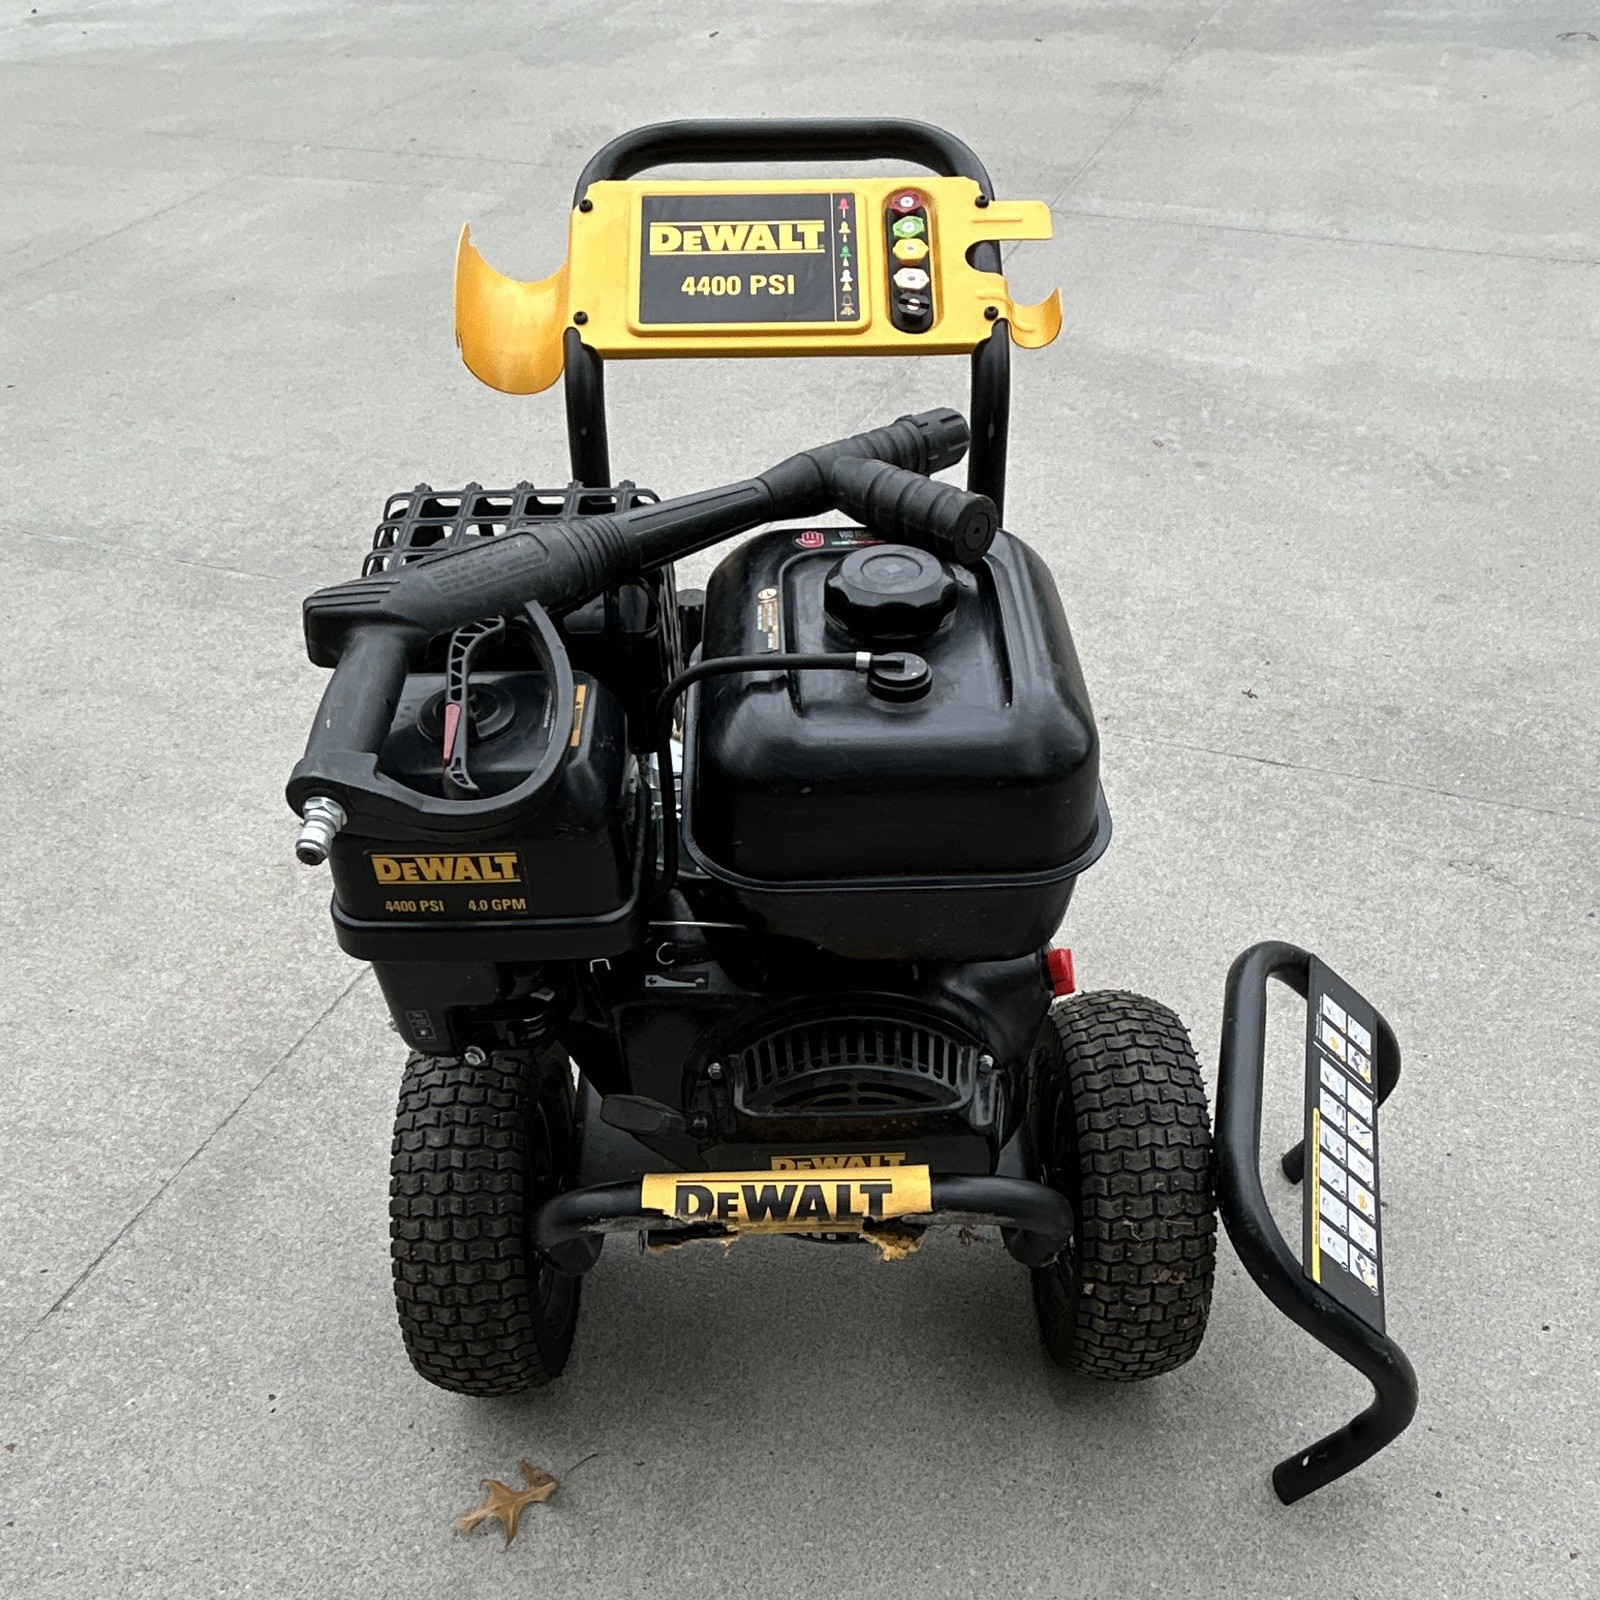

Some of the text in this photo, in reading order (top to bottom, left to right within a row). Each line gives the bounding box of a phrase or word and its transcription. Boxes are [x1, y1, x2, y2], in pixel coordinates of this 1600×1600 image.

[681, 274, 795, 296] 4400 PSI
[385, 898, 527, 912] 4400 PSI 4.0 GPM
